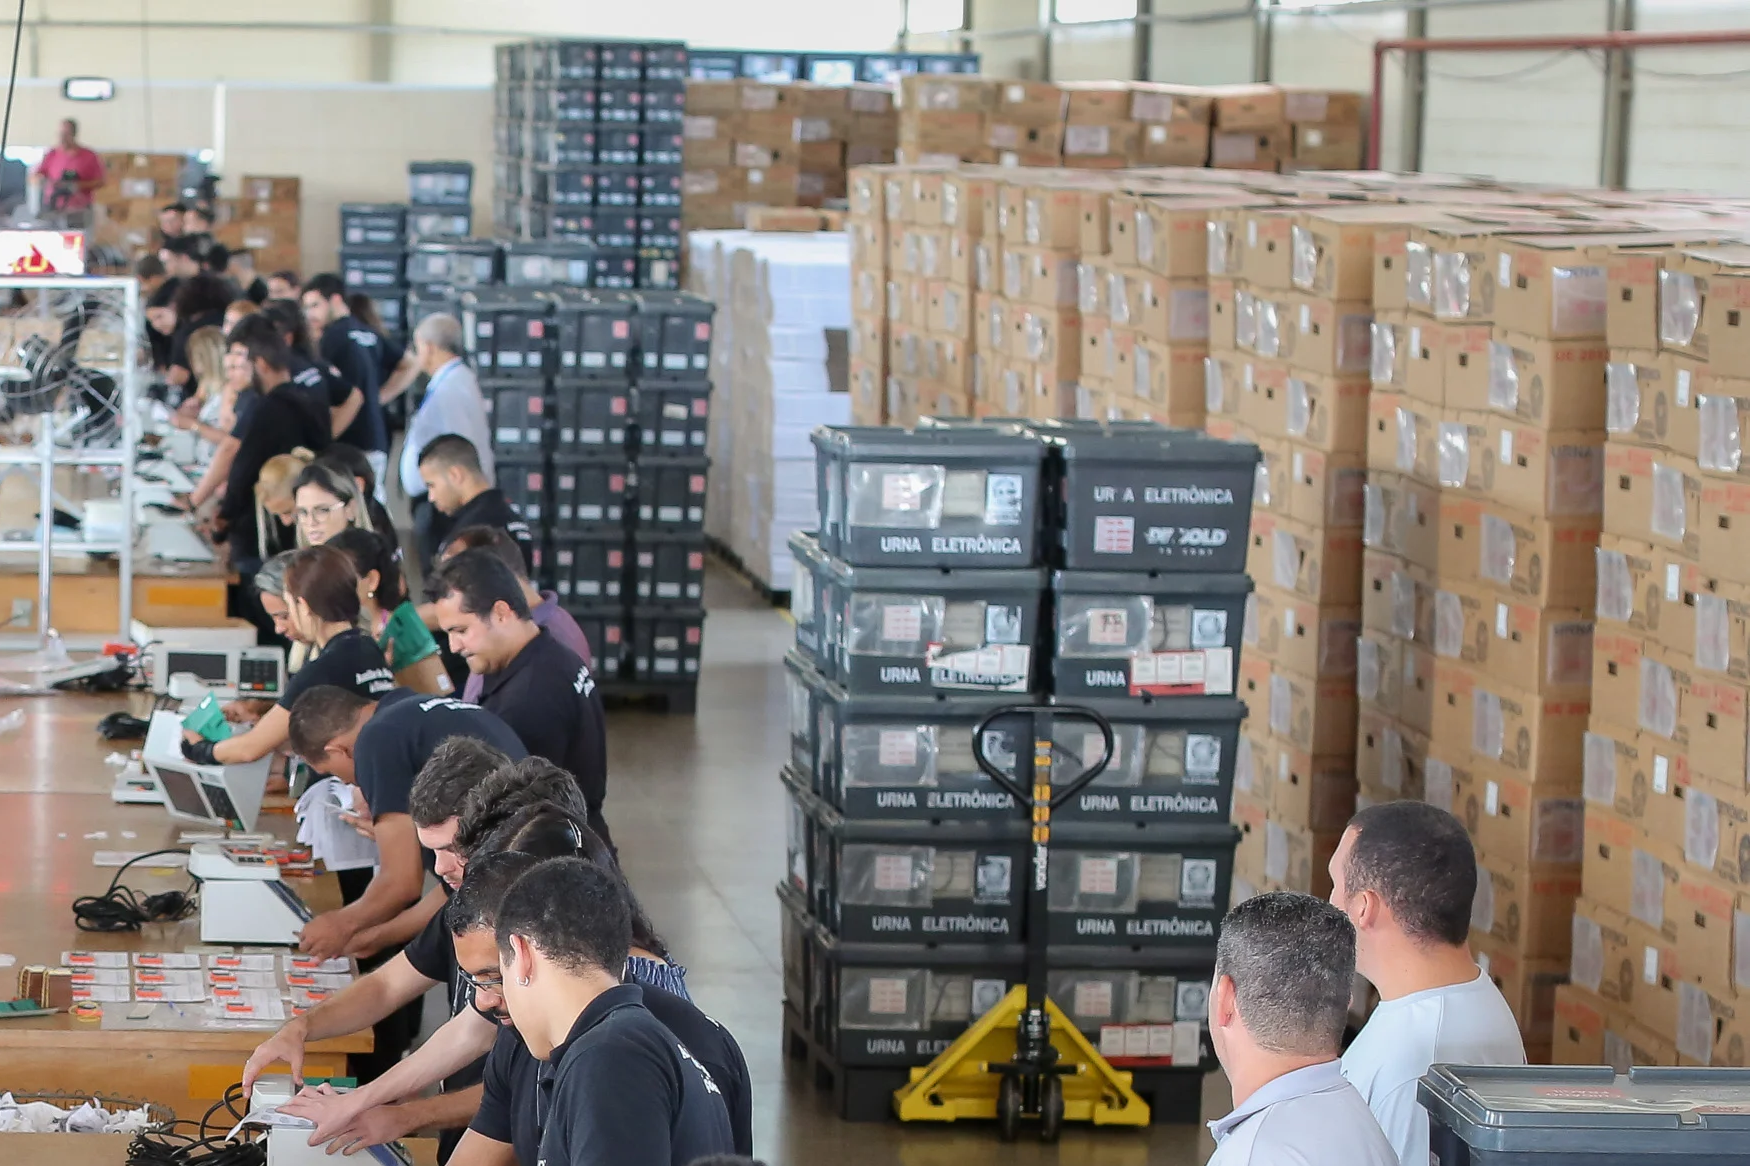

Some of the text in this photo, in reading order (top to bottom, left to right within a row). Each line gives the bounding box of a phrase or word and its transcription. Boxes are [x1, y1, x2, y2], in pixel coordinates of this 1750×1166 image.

[1094, 484, 1234, 504] URA ELETRÔNICA
[881, 533, 1022, 554] URNA ELETRÔNICA
[880, 668, 920, 684] URNA
[1086, 670, 1126, 687] URNA
[877, 791, 1015, 810] URNA ELETRÔNICA
[1081, 793, 1218, 813] URNA ELETRÔNICA
[872, 914, 1010, 934] URNA ELETRÔNICA
[1077, 917, 1213, 937] URNA ELETRÔNICA
[867, 1038, 906, 1055] URNA
